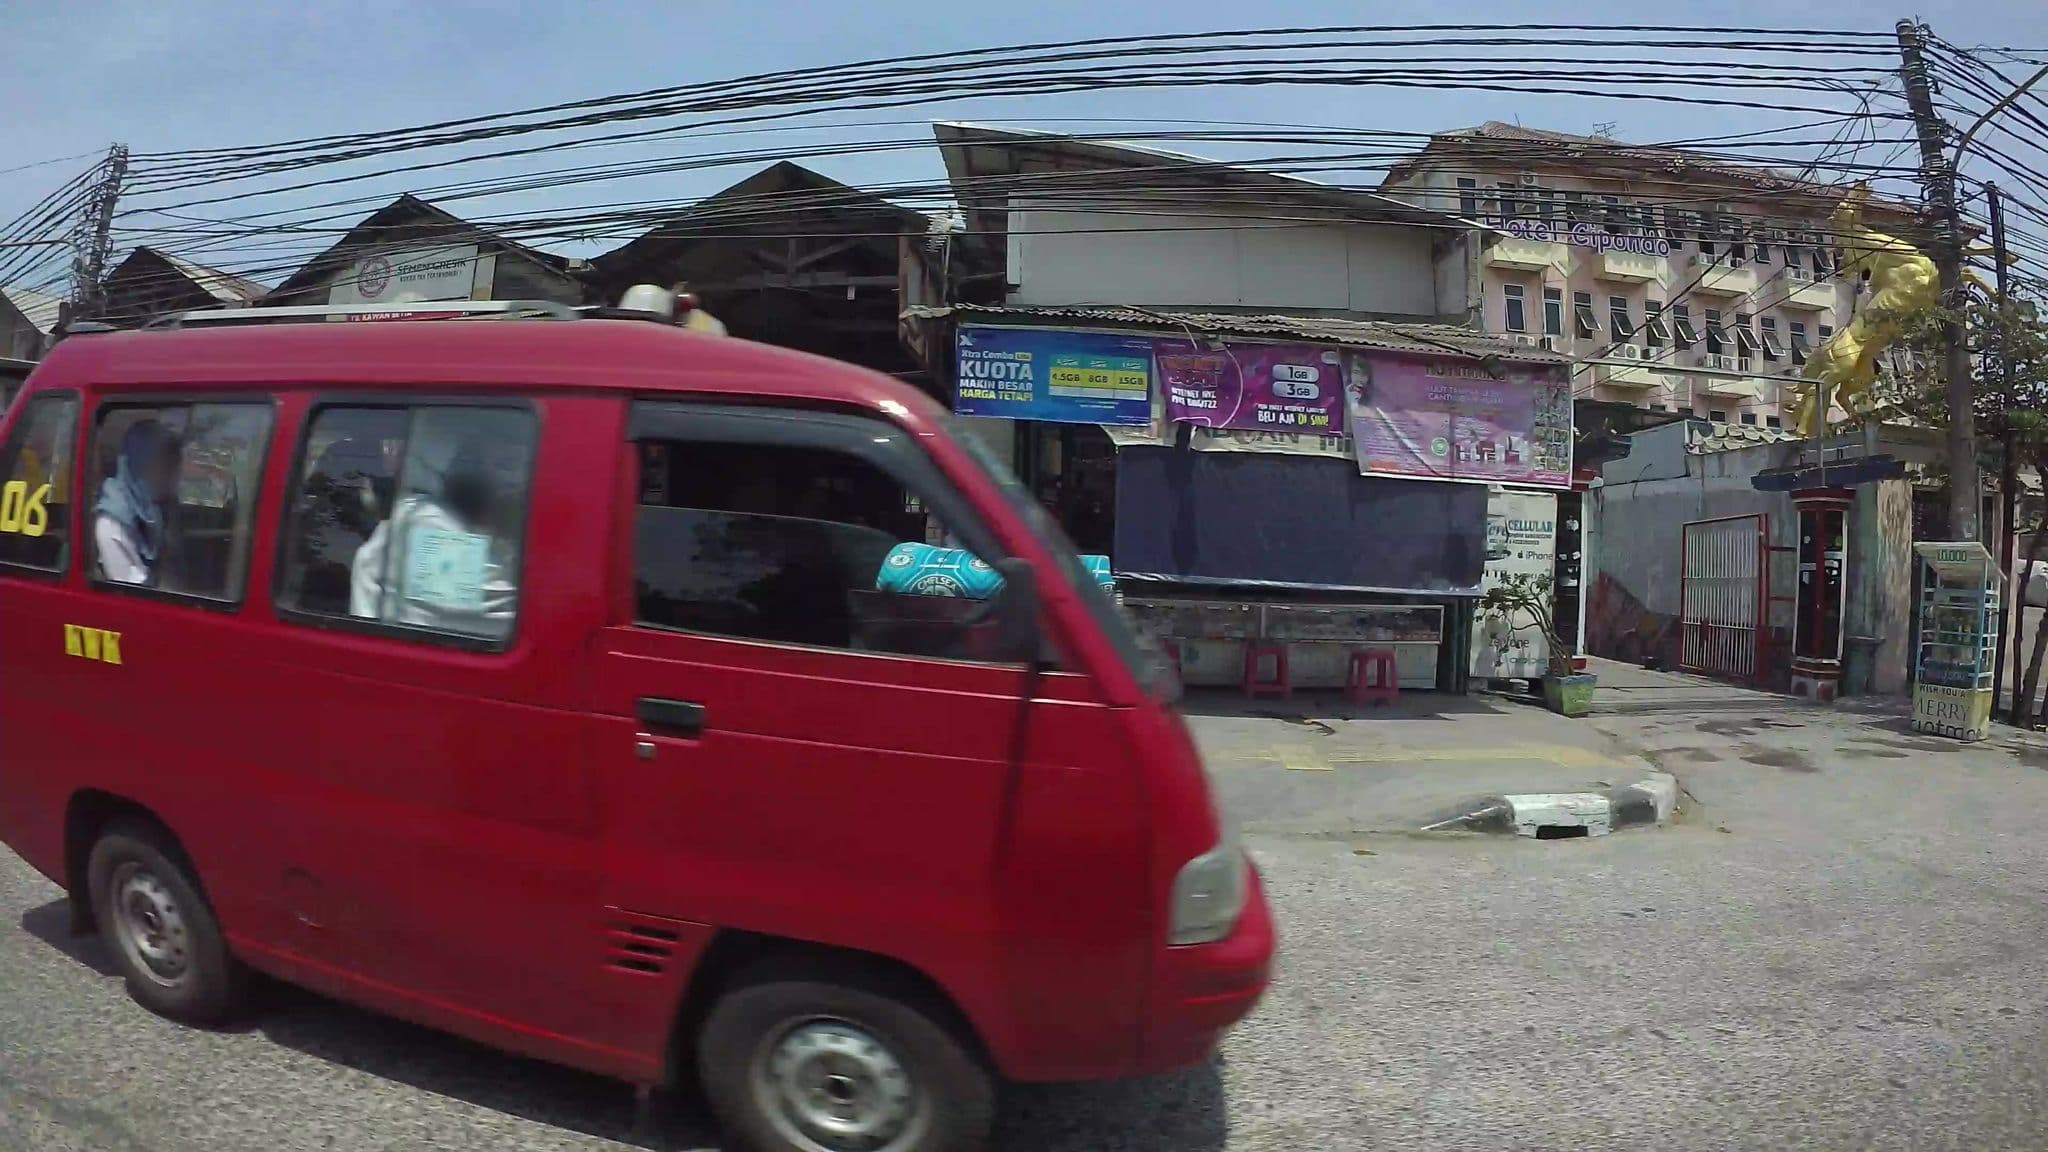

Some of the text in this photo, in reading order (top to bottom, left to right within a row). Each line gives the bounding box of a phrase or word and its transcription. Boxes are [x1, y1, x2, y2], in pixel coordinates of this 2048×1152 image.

[1484, 216, 1558, 243] Hotel
[982, 350, 1014, 359] Combo
[960, 360, 1033, 380] KUOTA
[960, 379, 1033, 391] MAKIN BESAR
[960, 388, 996, 399] HARGA
[1258, 410, 1276, 422] BELI
[1278, 412, 1296, 425] AJA
[1297, 414, 1307, 425] DI
[0, 480, 50, 537] 06
[1508, 520, 1553, 533] CELLULAR
[1525, 551, 1554, 561] iPhone
[917, 576, 956, 592] CHELSEA
